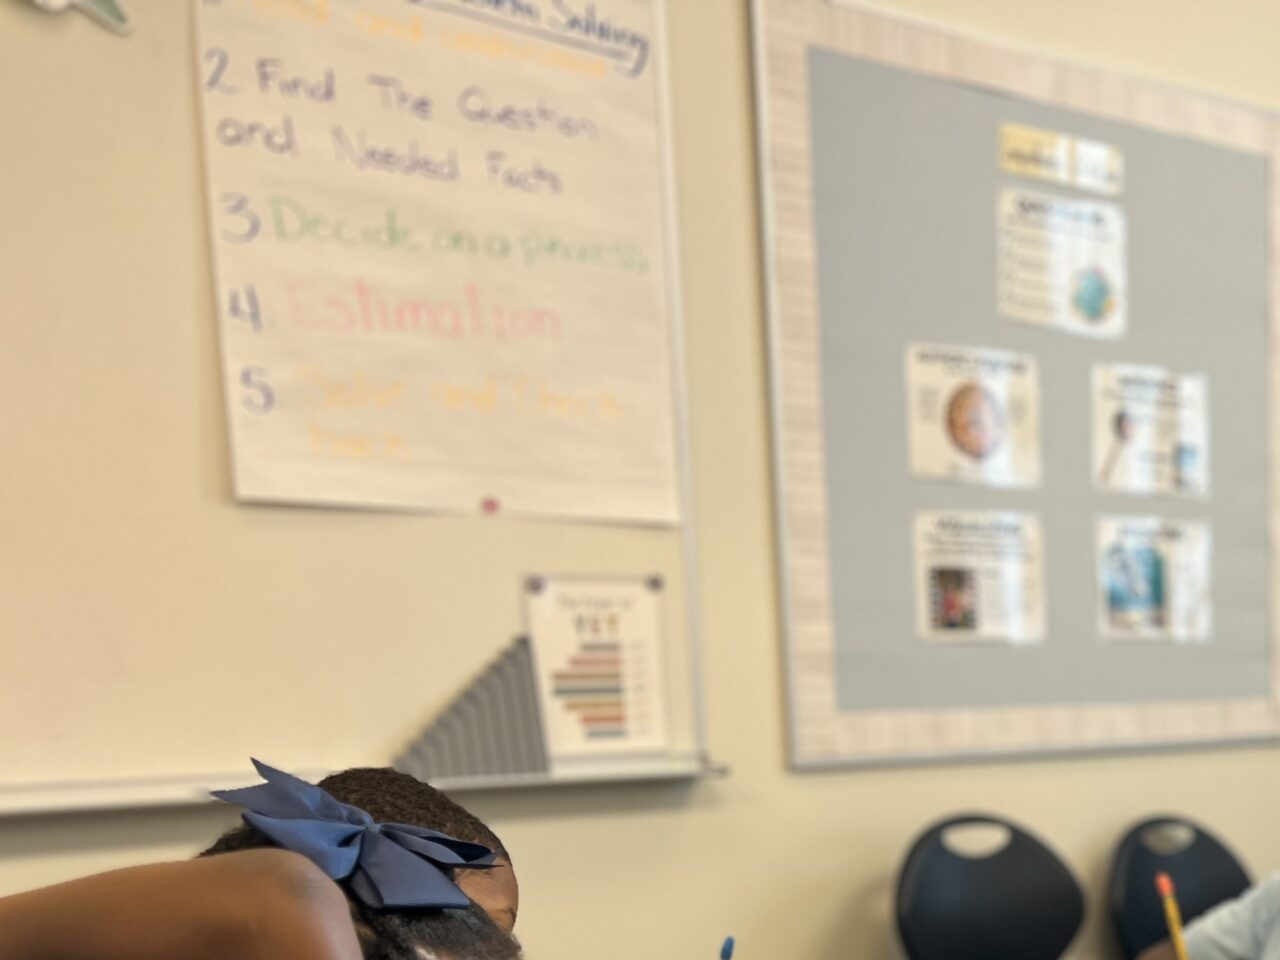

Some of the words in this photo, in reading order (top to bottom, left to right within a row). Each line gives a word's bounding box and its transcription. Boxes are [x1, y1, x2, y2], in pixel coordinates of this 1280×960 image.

[204, 46, 240, 96] 2
[255, 57, 336, 104] Find
[366, 73, 433, 121] The
[456, 85, 600, 139] Question
[215, 114, 297, 156] and
[330, 124, 462, 184] Needed
[485, 150, 564, 195] Facts
[266, 194, 424, 252] Decide
[286, 278, 563, 342] Estimation
